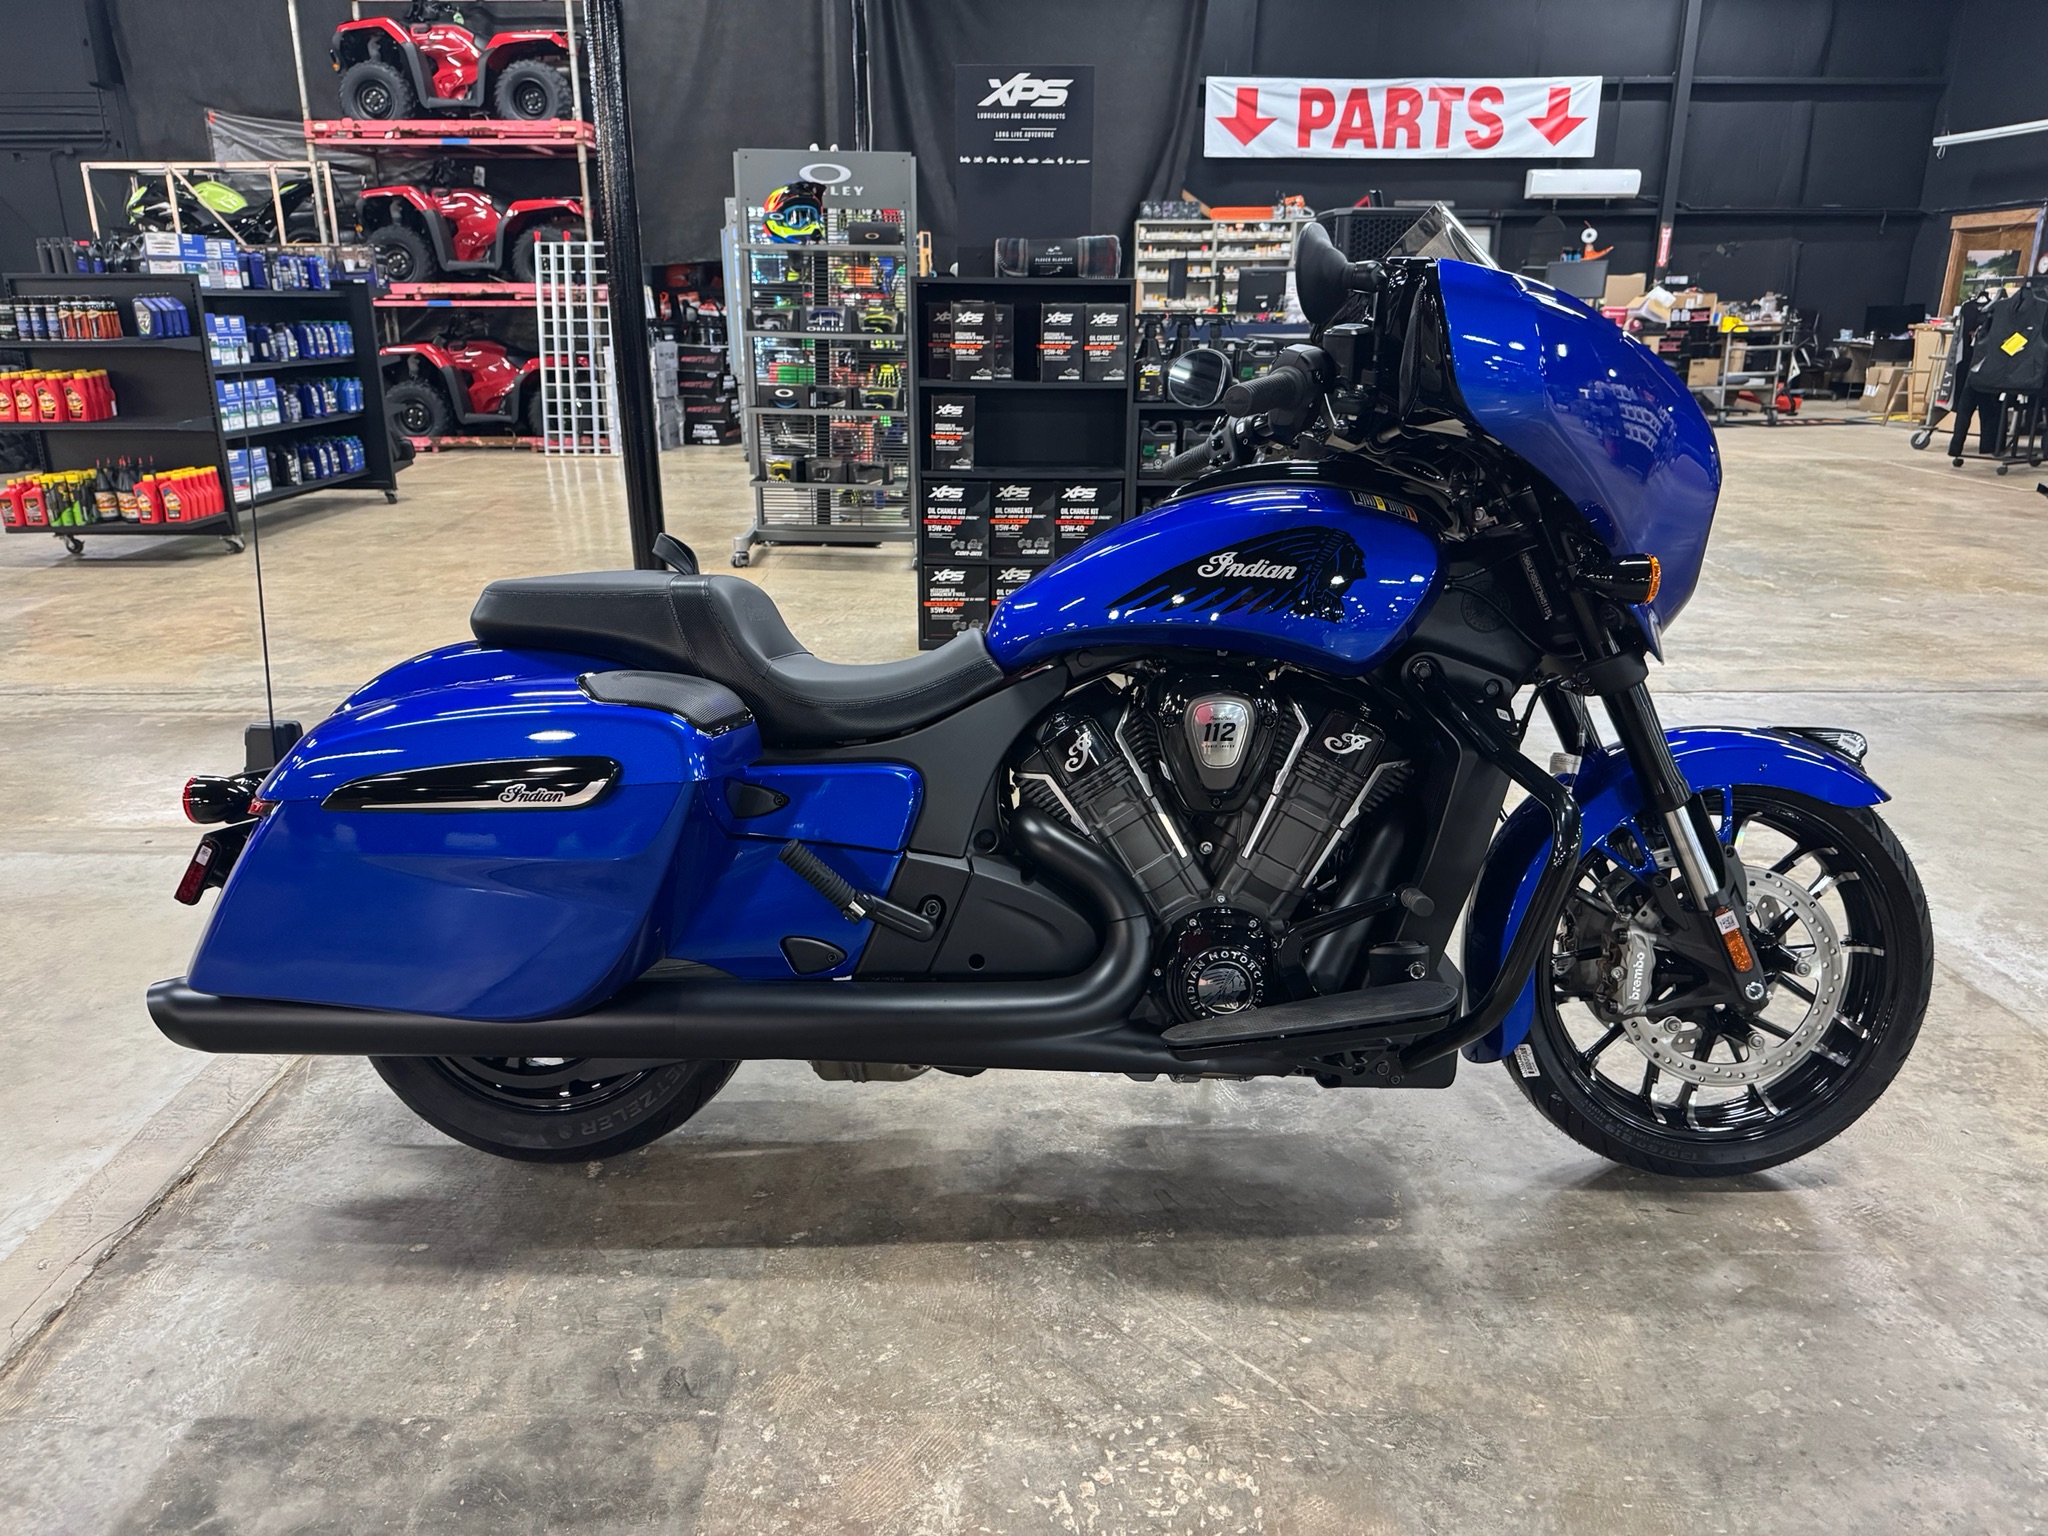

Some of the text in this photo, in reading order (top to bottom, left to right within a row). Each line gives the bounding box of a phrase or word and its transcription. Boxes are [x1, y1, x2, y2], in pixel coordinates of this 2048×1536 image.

[977, 72, 1074, 107] XPS
[977, 112, 1009, 120] LUBRICANTS
[1011, 112, 1021, 120] AND
[1297, 86, 1504, 149] PARTS
[933, 311, 951, 322] XP
[955, 311, 985, 323] XPS
[1044, 311, 1074, 323] XPS
[1089, 312, 1119, 324] XPS
[1940, 371, 1953, 397] FLY
[935, 404, 964, 415] XPS
[928, 485, 965, 498] XPS
[996, 484, 1032, 498] XPS
[1061, 485, 1098, 498] XPS
[1197, 551, 1298, 580] Indian
[930, 568, 966, 582] XPS
[997, 567, 1033, 580] XPS
[1203, 722, 1236, 742] 112
[498, 784, 566, 804] Indian
[1629, 951, 1646, 1001] brembo
[1187, 960, 1206, 1011] INDIAN
